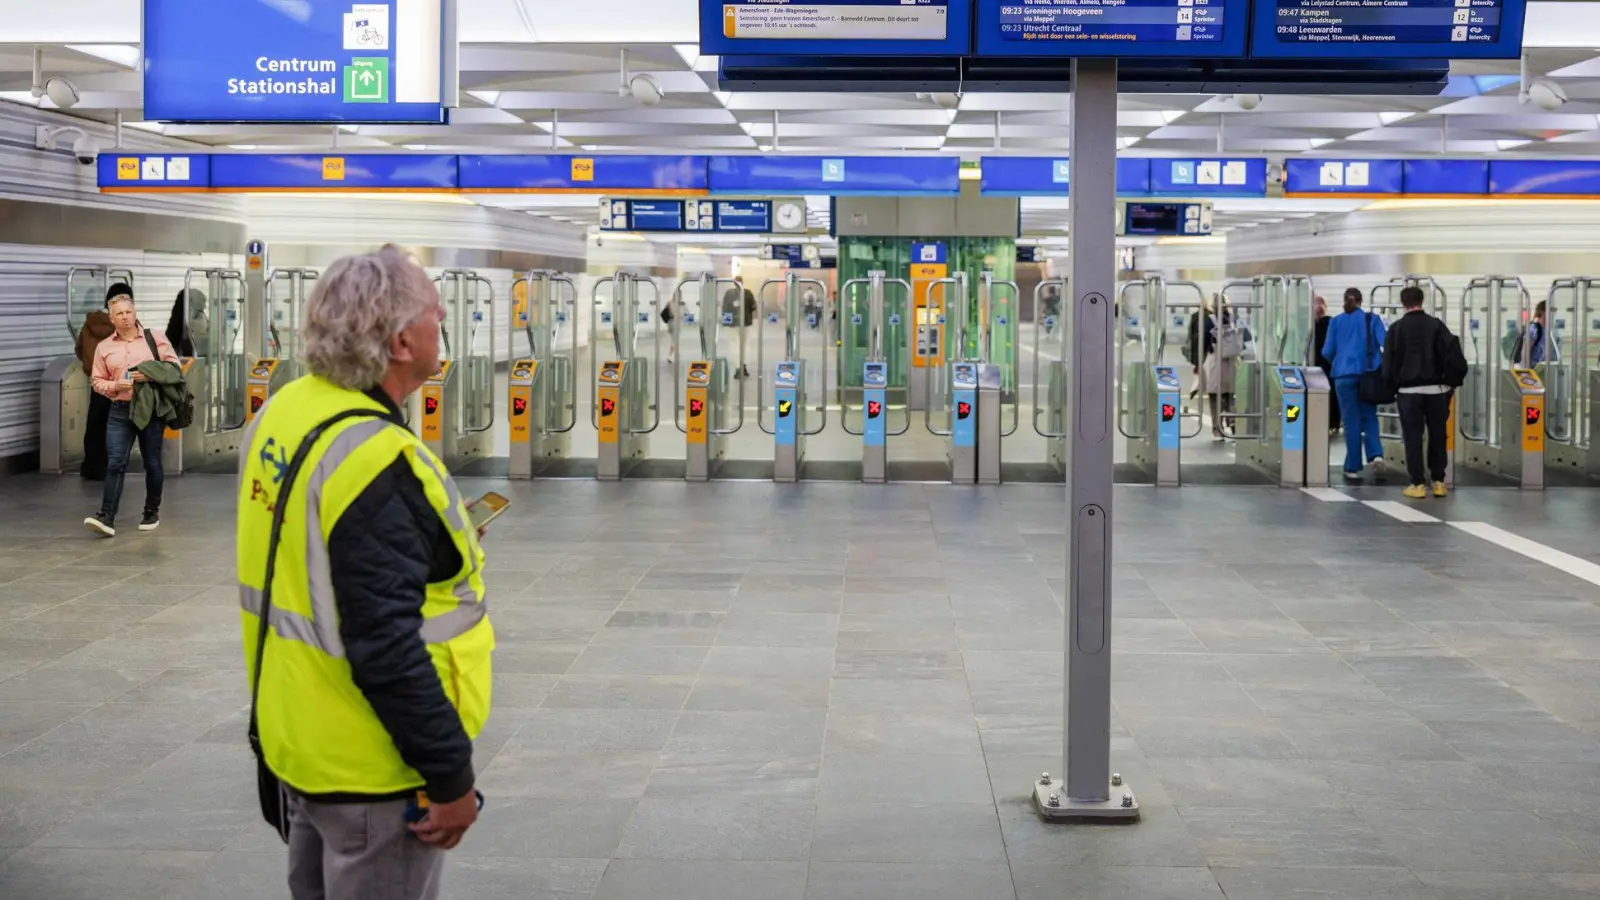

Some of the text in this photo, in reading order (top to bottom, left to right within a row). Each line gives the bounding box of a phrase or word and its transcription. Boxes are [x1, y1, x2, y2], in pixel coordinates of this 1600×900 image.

[1024, 7, 1061, 16] Groningen
[1063, 8, 1103, 16] Hoogeveen
[1300, 9, 1329, 17] Kampen
[256, 56, 336, 72] Centrum
[227, 78, 336, 94] Stationshal
